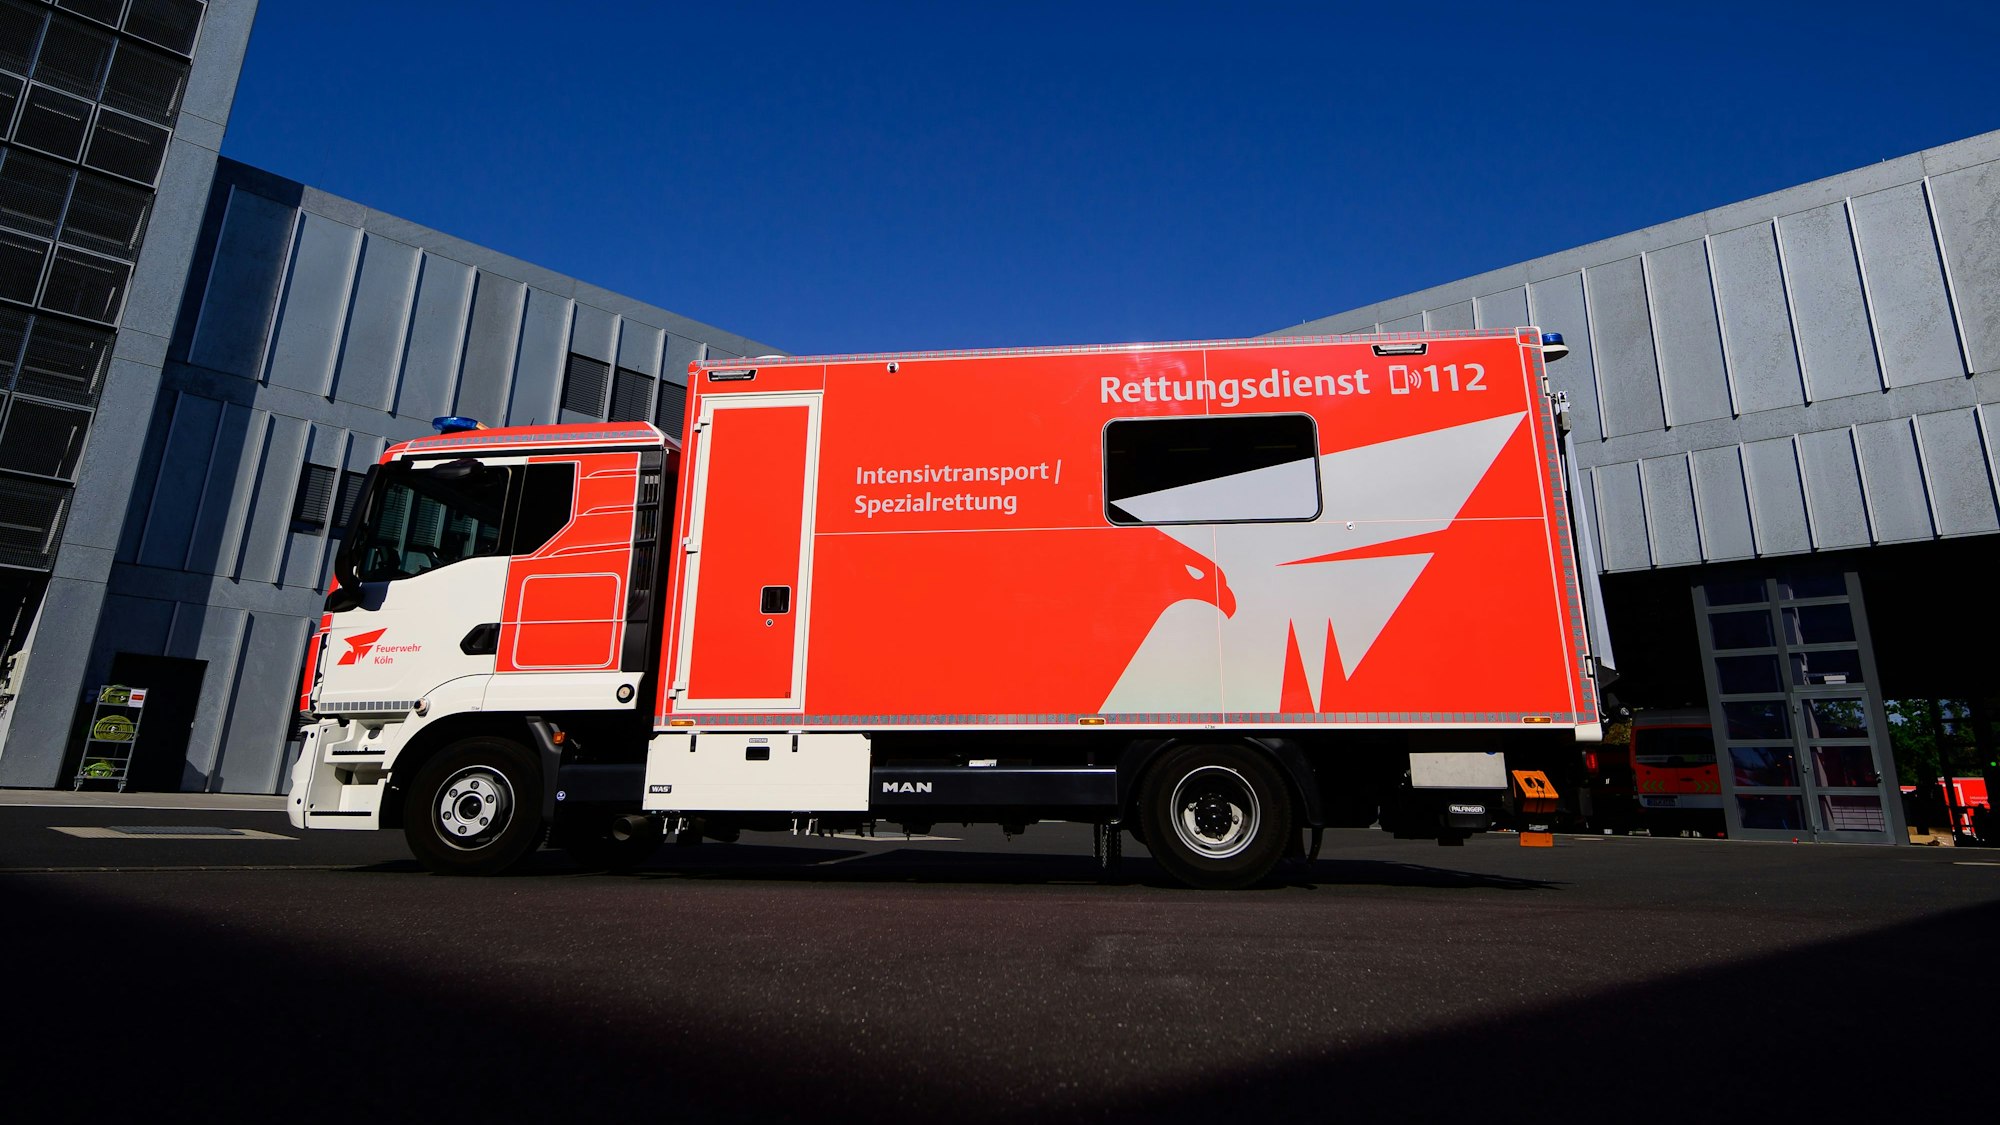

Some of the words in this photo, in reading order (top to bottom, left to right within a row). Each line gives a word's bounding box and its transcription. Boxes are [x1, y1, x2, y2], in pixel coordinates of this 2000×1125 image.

[1100, 368, 1370, 407] Rettungsdienst
[1423, 363, 1487, 392] 112
[856, 464, 1049, 486] Intensivtransport
[854, 492, 1017, 518] Spezialrettung
[375, 644, 422, 654] Feuerwehr
[374, 655, 394, 665] Köln
[882, 782, 932, 793] MAN
[1451, 805, 1483, 813] PALFINGER
